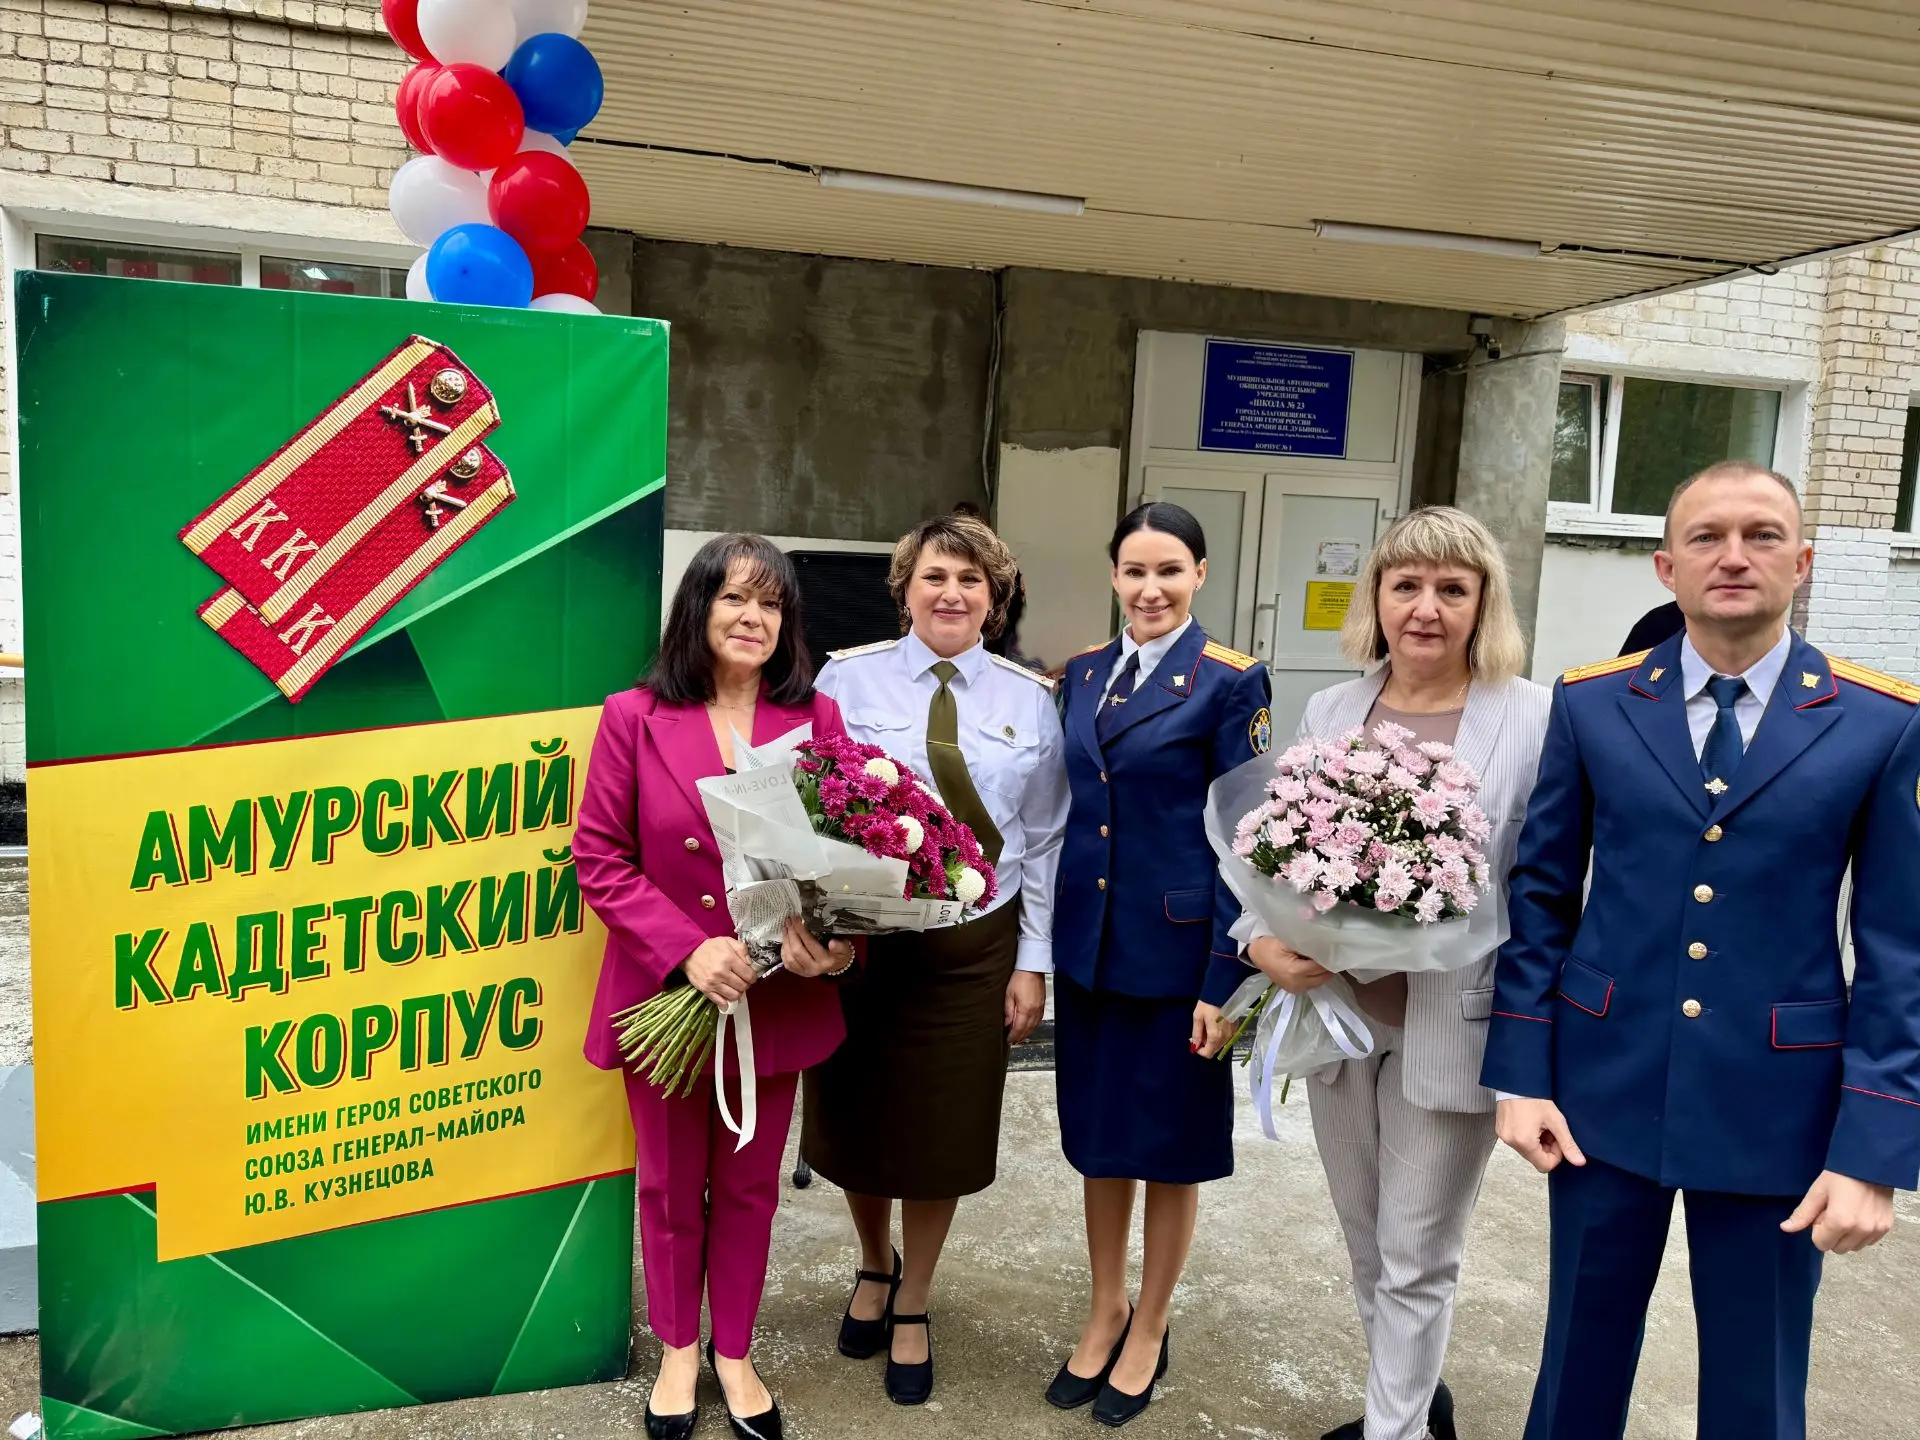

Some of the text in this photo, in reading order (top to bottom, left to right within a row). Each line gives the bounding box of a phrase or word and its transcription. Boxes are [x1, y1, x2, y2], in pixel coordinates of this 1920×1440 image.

[1287, 401, 1295, 409] №
[1296, 402, 1305, 410] 23
[129, 737, 575, 892] АМУРСКИЙ
[114, 848, 585, 1010] КАДЕТСКИЙ
[245, 977, 543, 1100] КОРПУС
[245, 1106, 526, 1181] СОЮЗА ГЕНЕРАЛ-МАЙОРА
[246, 1068, 543, 1146] ИМЕНИ ГЕРОЯ СОВЕТСКОГО
[244, 1159, 435, 1216] Ю.В. КУЗНЕЦОВА
